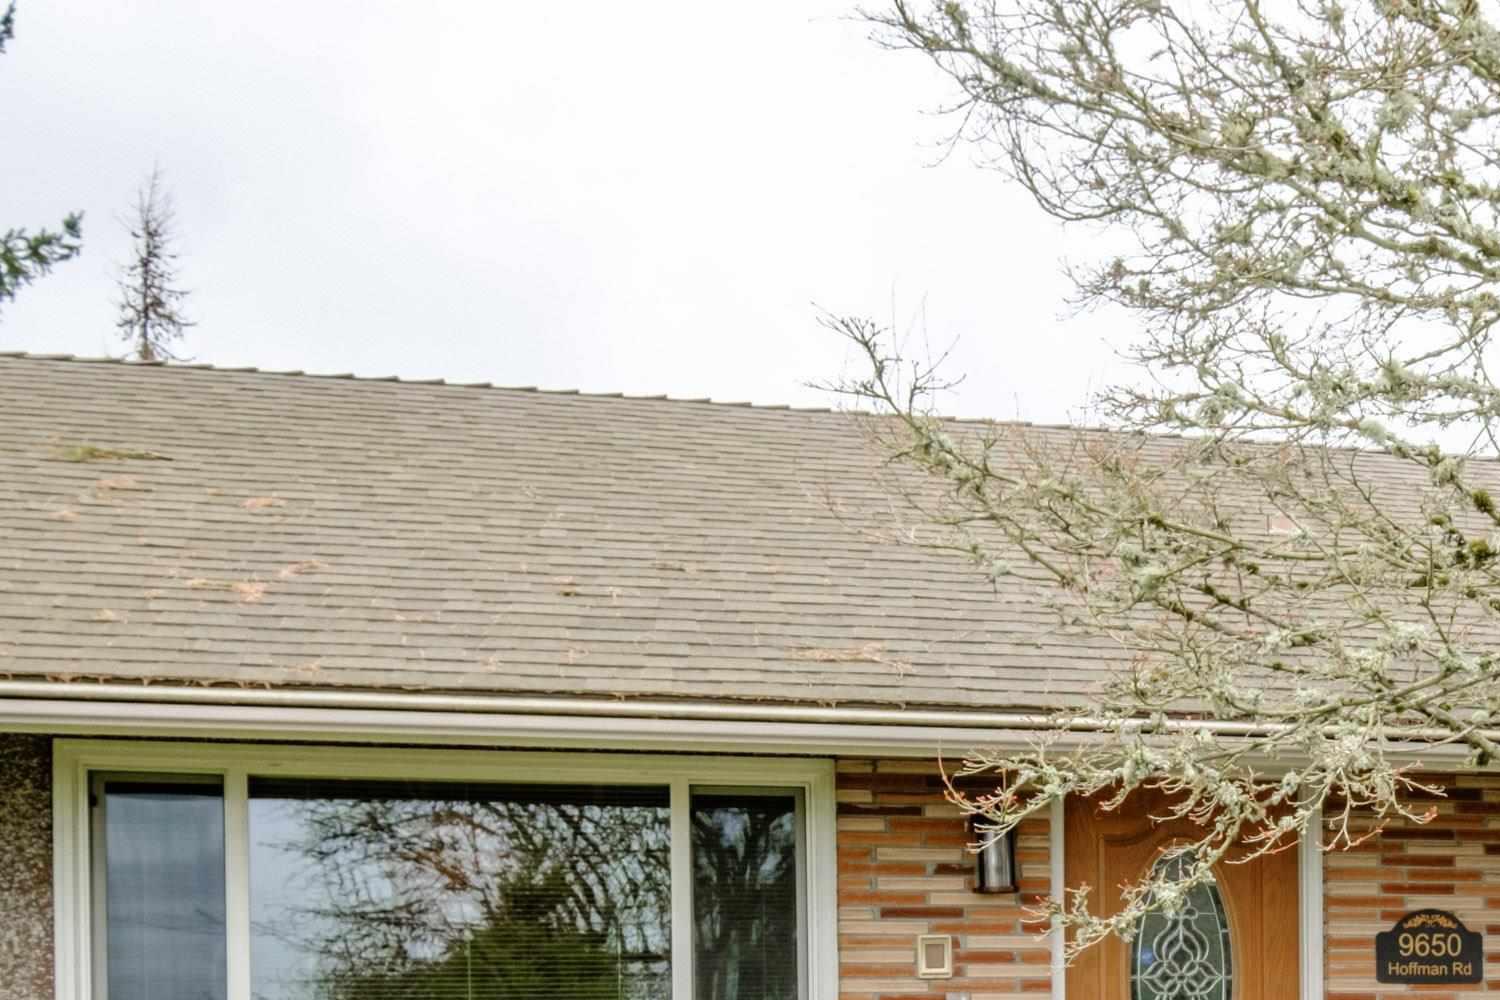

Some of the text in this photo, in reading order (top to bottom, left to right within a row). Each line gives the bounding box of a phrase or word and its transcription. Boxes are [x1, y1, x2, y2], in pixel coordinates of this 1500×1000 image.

[1398, 933, 1462, 957] 9650
[1388, 962, 1472, 976] Hoffman Rd
